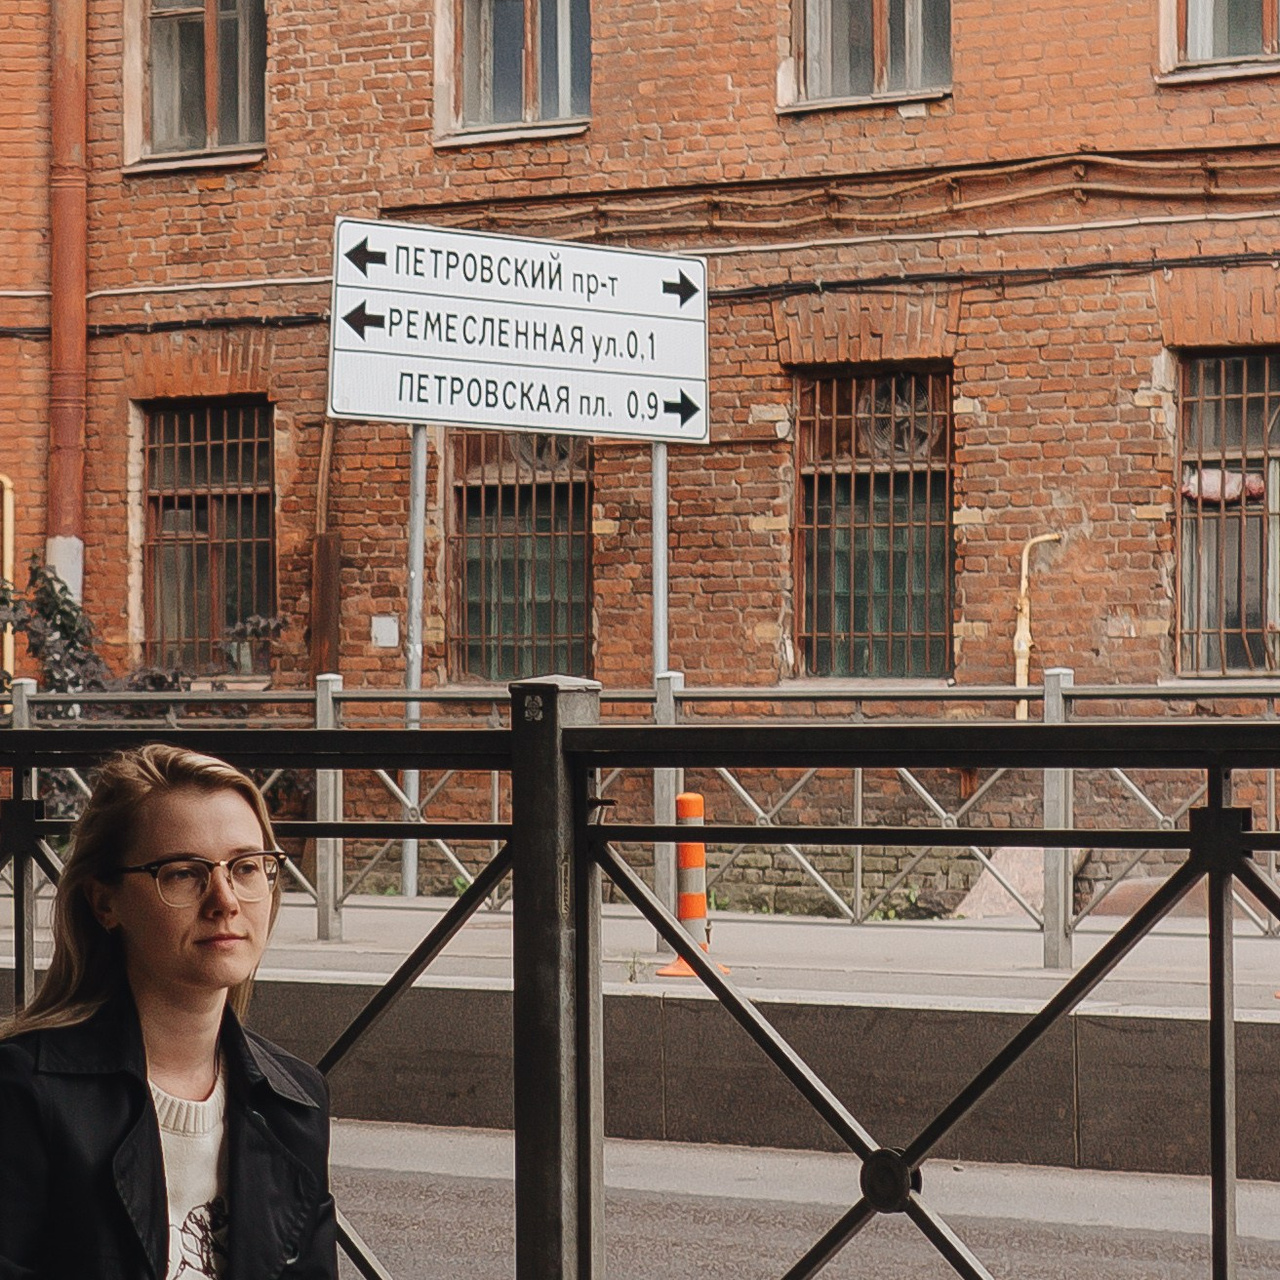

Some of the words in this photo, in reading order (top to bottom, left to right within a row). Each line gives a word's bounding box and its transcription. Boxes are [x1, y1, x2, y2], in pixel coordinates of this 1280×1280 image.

[395, 245, 562, 294] ПЕТРОВСКИЙ
[572, 273, 619, 302] пр-т
[388, 307, 584, 354] РЕМЕСЛЕННАЯ
[398, 371, 570, 414] ПЕТРОВСКАЯ
[579, 395, 612, 417] пл.
[626, 390, 659, 422] 0,9
